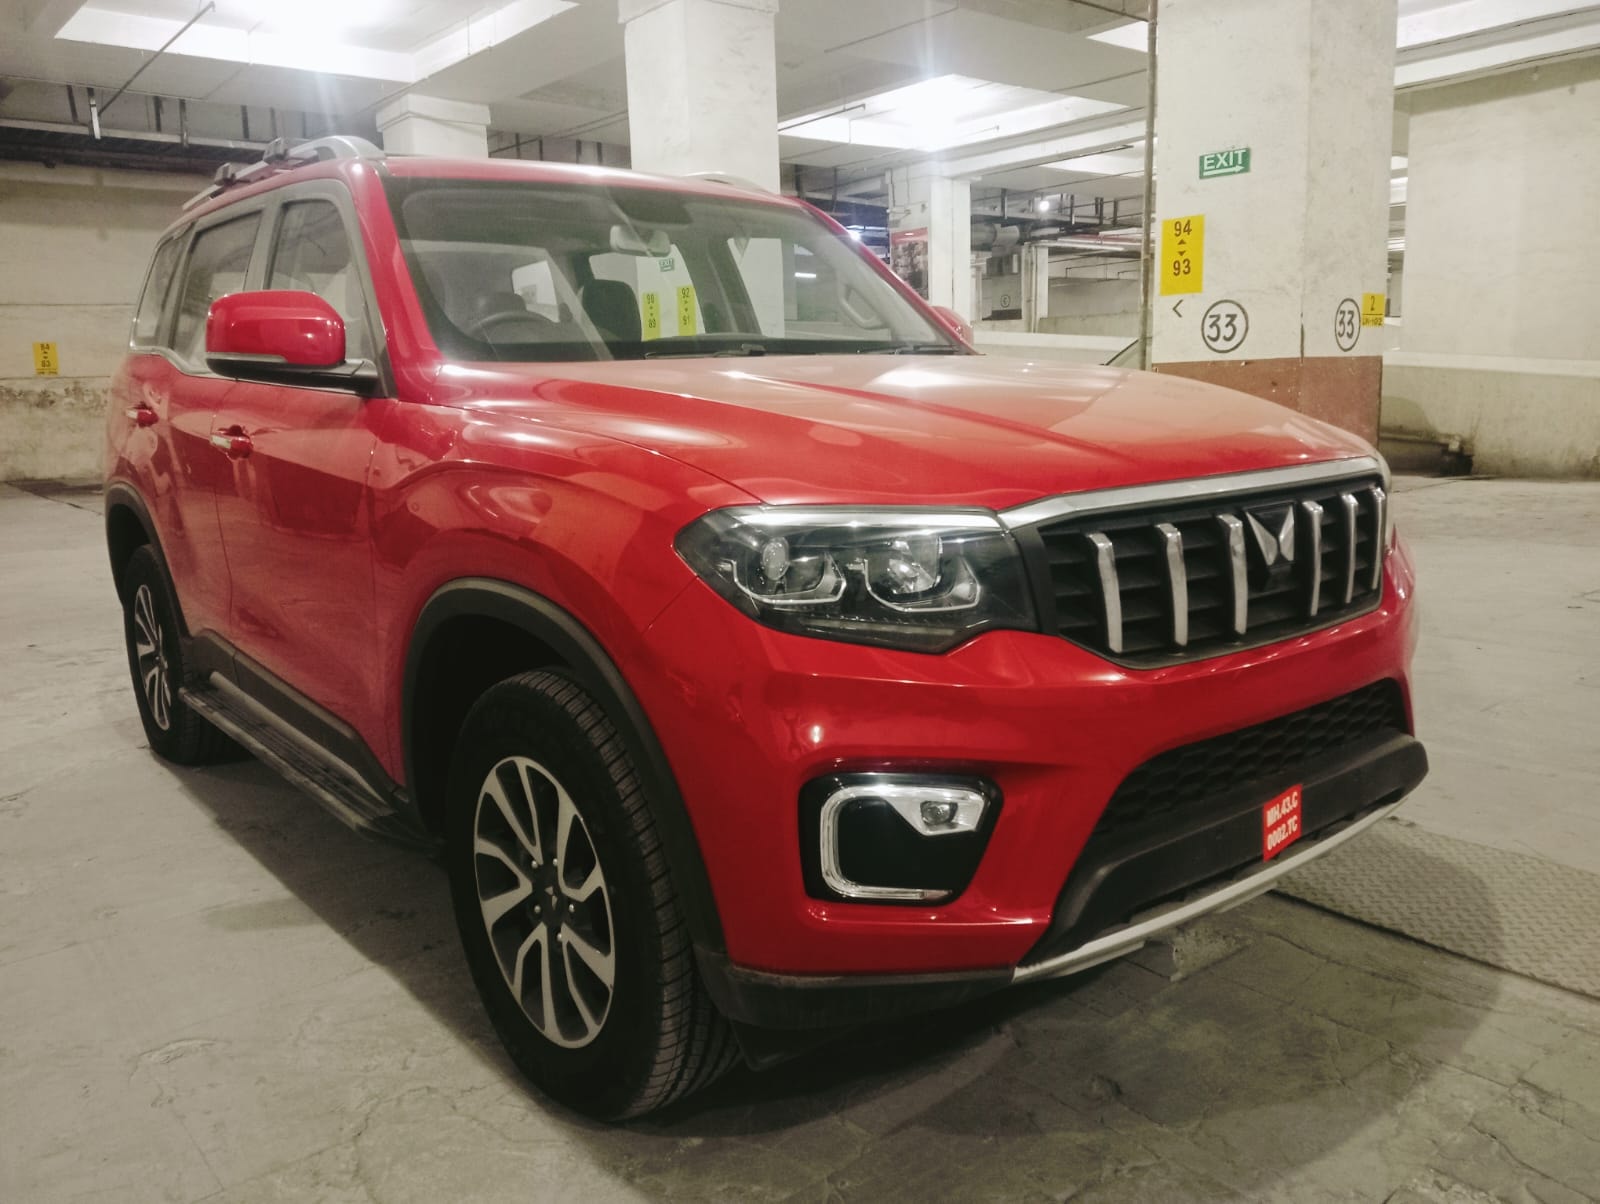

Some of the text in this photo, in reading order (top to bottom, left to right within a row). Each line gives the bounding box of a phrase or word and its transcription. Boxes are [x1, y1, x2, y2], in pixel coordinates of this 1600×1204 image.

[1203, 149, 1246, 170] EXIT
[1174, 219, 1192, 237] 94
[1173, 258, 1191, 277] 93
[1206, 313, 1238, 343] 33
[1337, 310, 1354, 339] 33
[1266, 791, 1298, 828] MH.43.C
